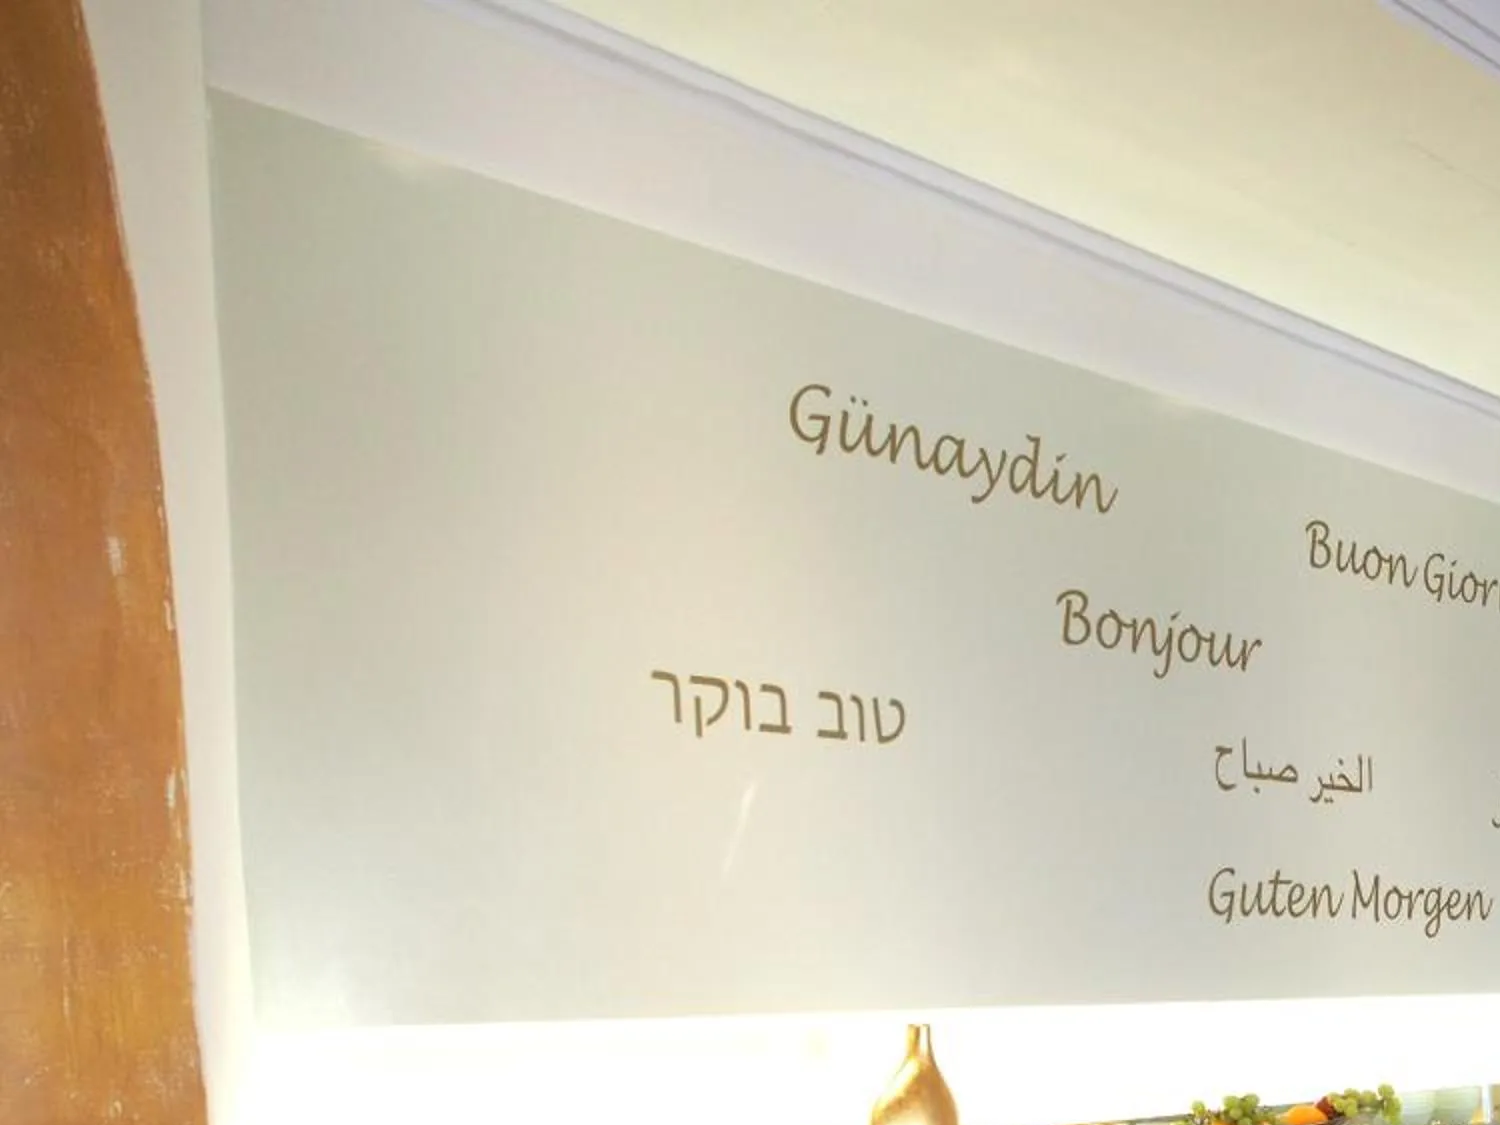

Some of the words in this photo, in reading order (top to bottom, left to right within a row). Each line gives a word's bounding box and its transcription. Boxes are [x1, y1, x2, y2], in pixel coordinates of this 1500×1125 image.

[789, 383, 1119, 515] Günaydin
[1305, 519, 1419, 588] Buon
[1056, 589, 1263, 680] Bonjour
[650, 669, 793, 738] בוקר
[816, 690, 906, 745] טוב
[1215, 737, 1299, 794] صباح
[1309, 754, 1373, 804] الخير
[1208, 867, 1345, 925] Guten
[1351, 869, 1493, 939] Morgen
